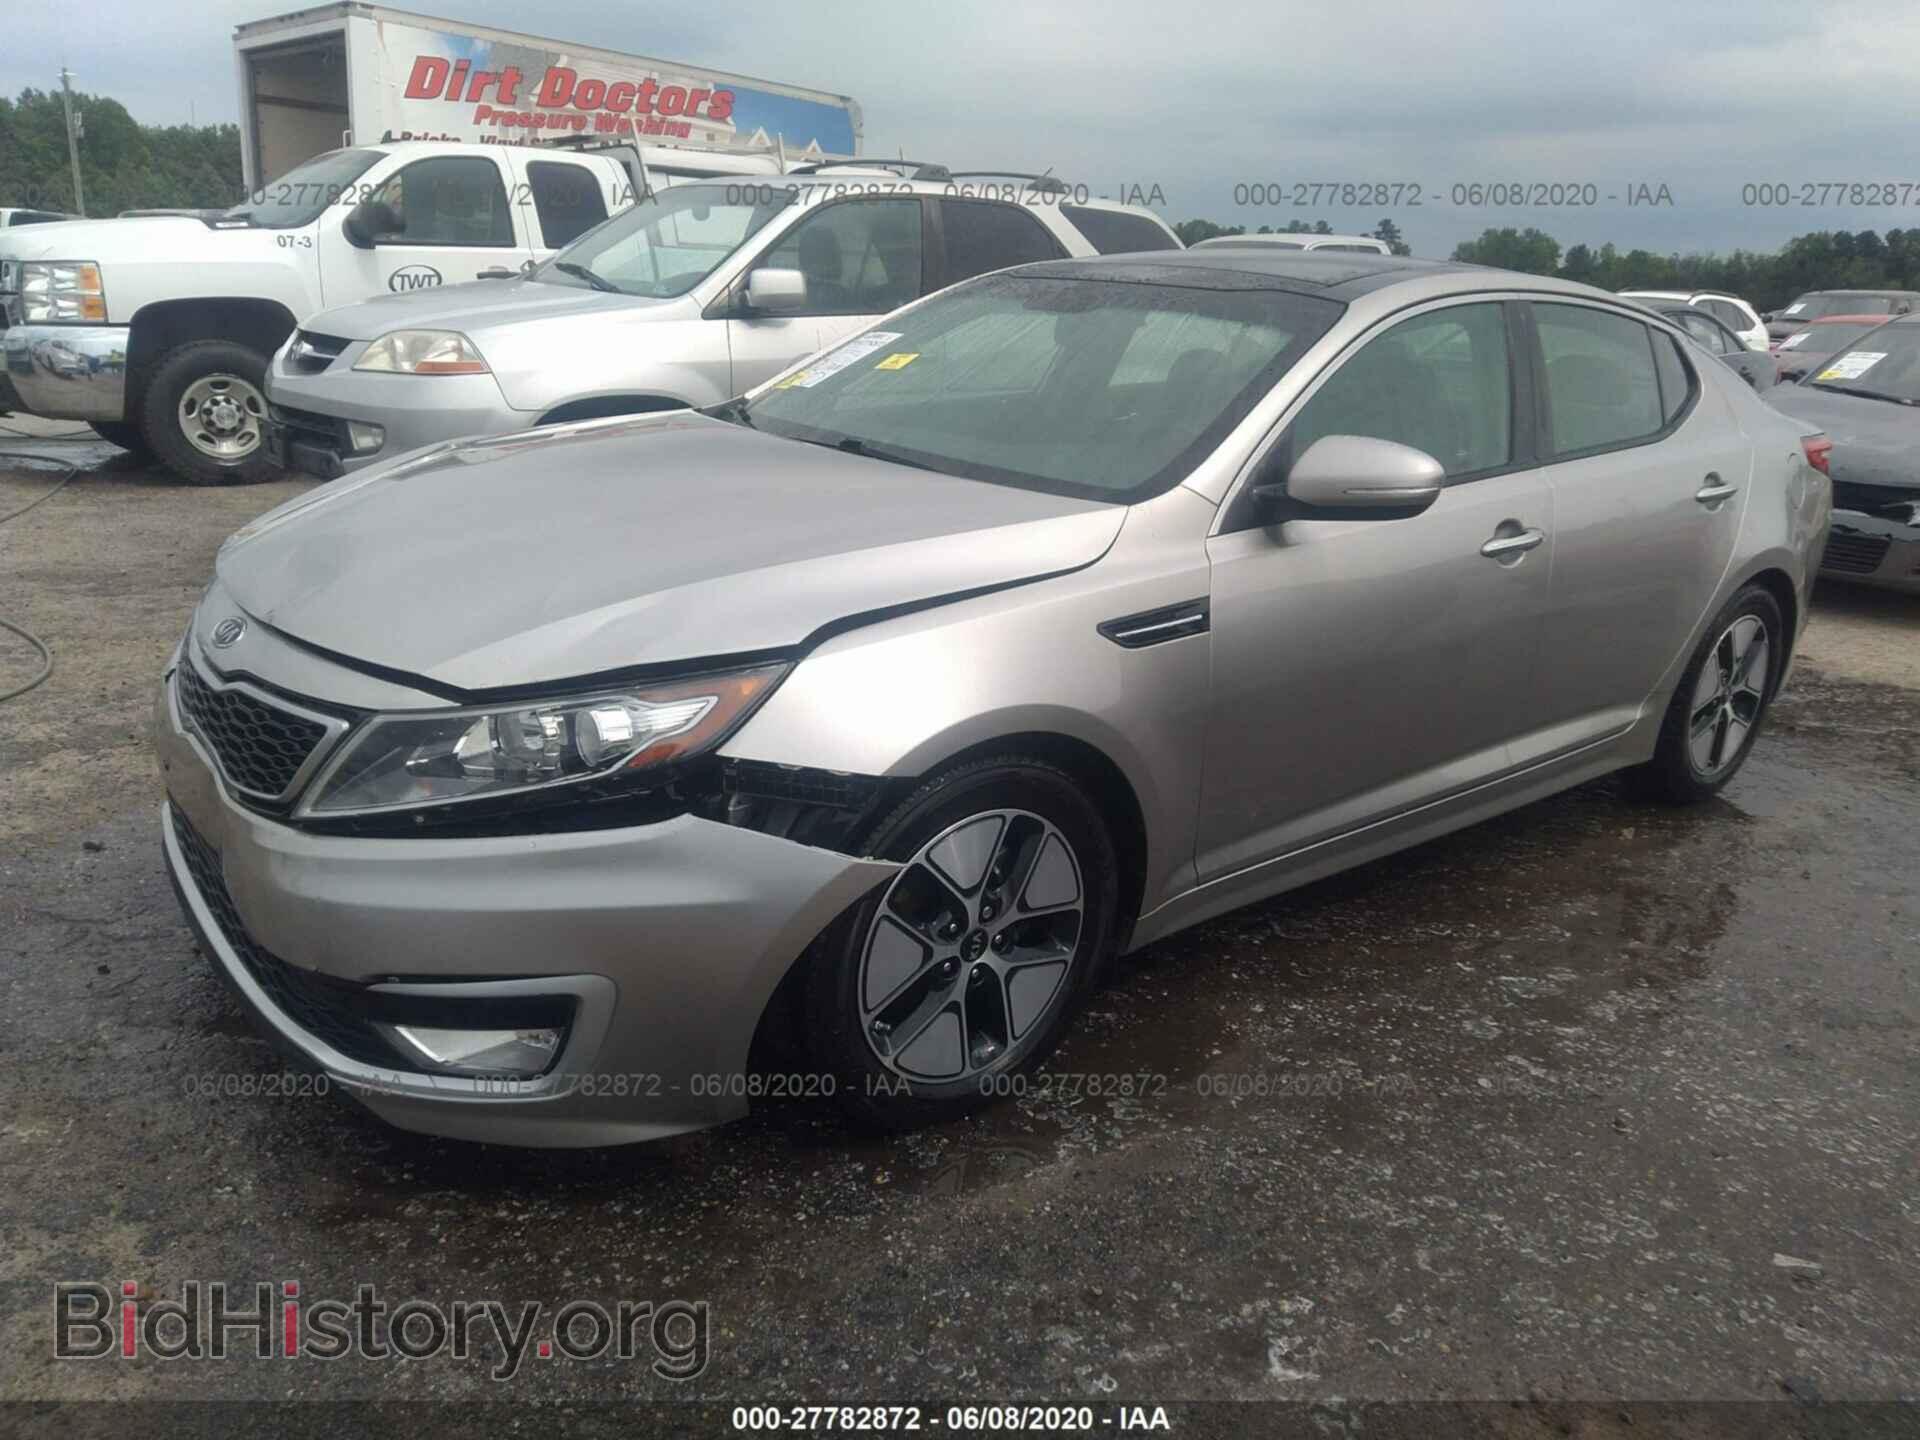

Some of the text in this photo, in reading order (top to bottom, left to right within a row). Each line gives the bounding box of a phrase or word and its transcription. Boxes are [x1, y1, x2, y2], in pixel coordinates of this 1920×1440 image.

[404, 55, 736, 119] Dirt Doctors
[473, 104, 586, 131] Pressure
[276, 234, 312, 248] 07-3
[396, 274, 436, 291] TWT
